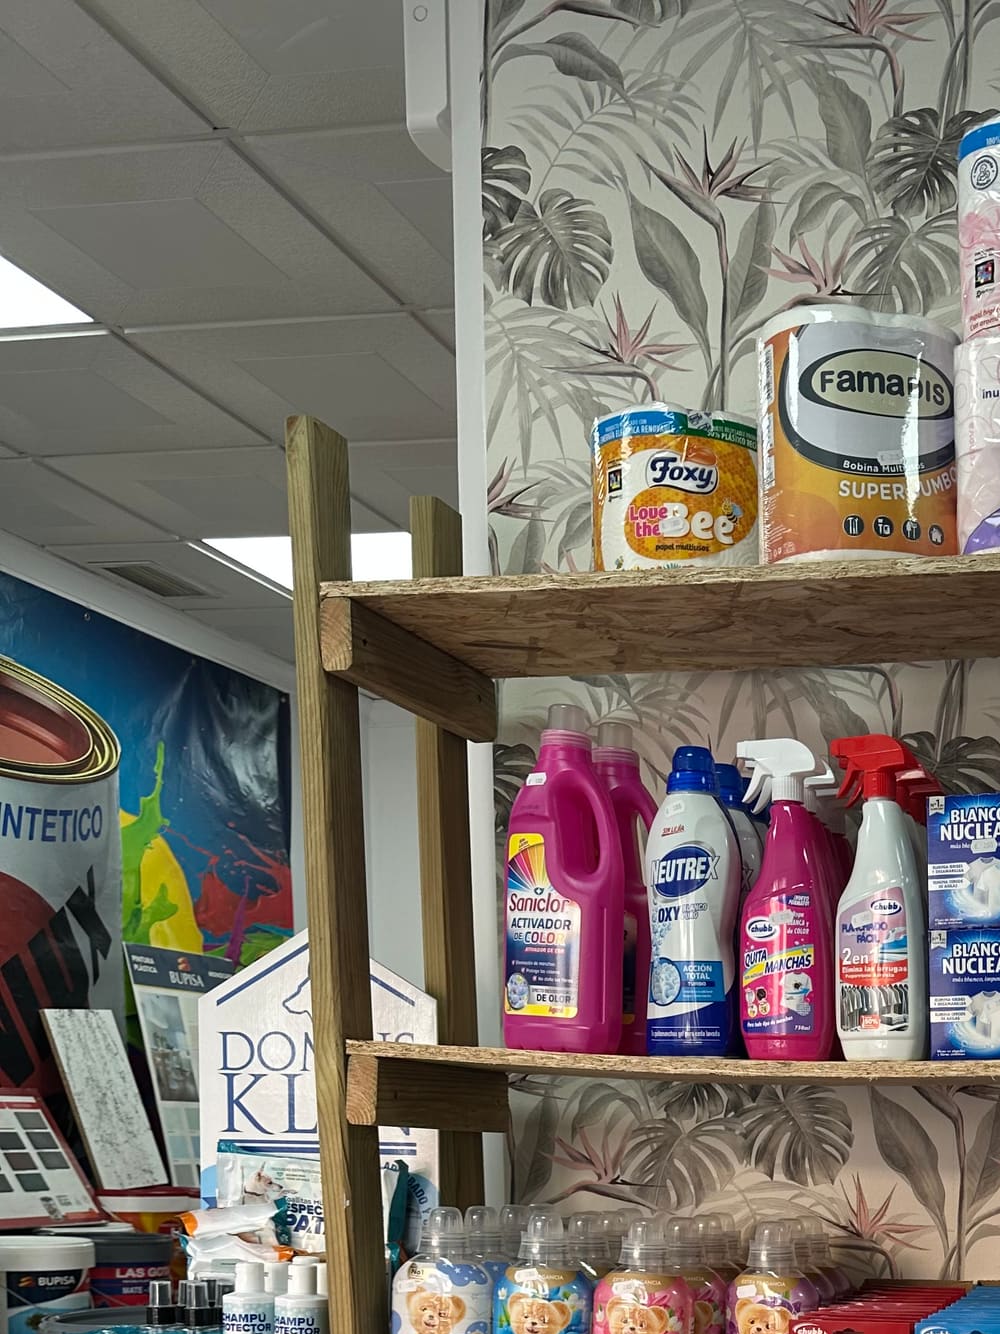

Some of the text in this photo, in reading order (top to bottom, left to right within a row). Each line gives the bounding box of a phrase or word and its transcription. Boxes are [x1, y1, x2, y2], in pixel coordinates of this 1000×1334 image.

[651, 457, 713, 488] Foxy
[843, 460, 878, 473] Bobina
[629, 506, 668, 521] Love
[660, 503, 735, 544] Bee
[651, 856, 720, 884] NEUTREX
[509, 893, 569, 912] Saniclor
[658, 906, 680, 921] OXY
[511, 918, 571, 930] ACTIVADOR
[524, 932, 566, 944] COLOR
[746, 950, 766, 967] QUITA
[765, 955, 811, 974] MANCHAS
[168, 971, 205, 987] BUPISA
[115, 1268, 145, 1278] LAS
[38, 1276, 75, 1286] BUPISA
